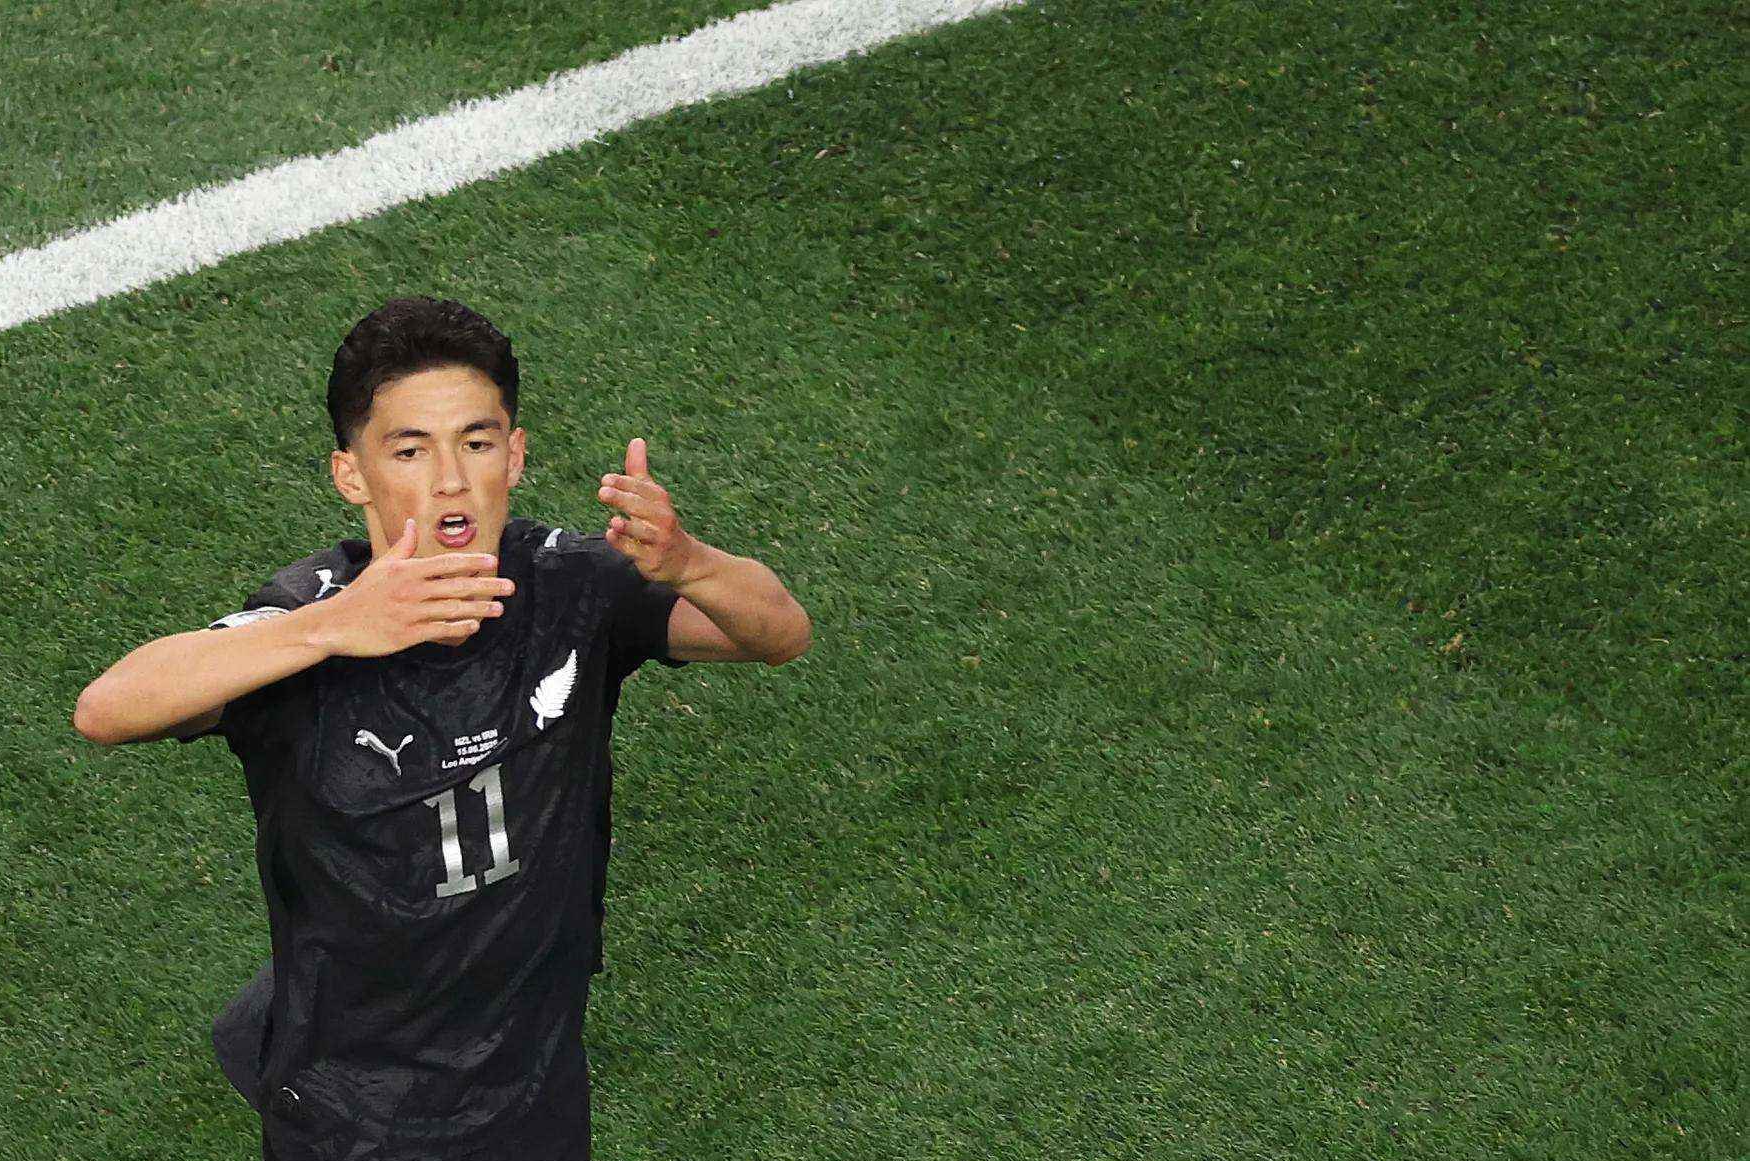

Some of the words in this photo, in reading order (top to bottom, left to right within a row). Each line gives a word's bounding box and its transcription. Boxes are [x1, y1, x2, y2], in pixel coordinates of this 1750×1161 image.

[441, 760, 458, 769] Los
[458, 750, 492, 766] Ange
[423, 763, 520, 898] 11
